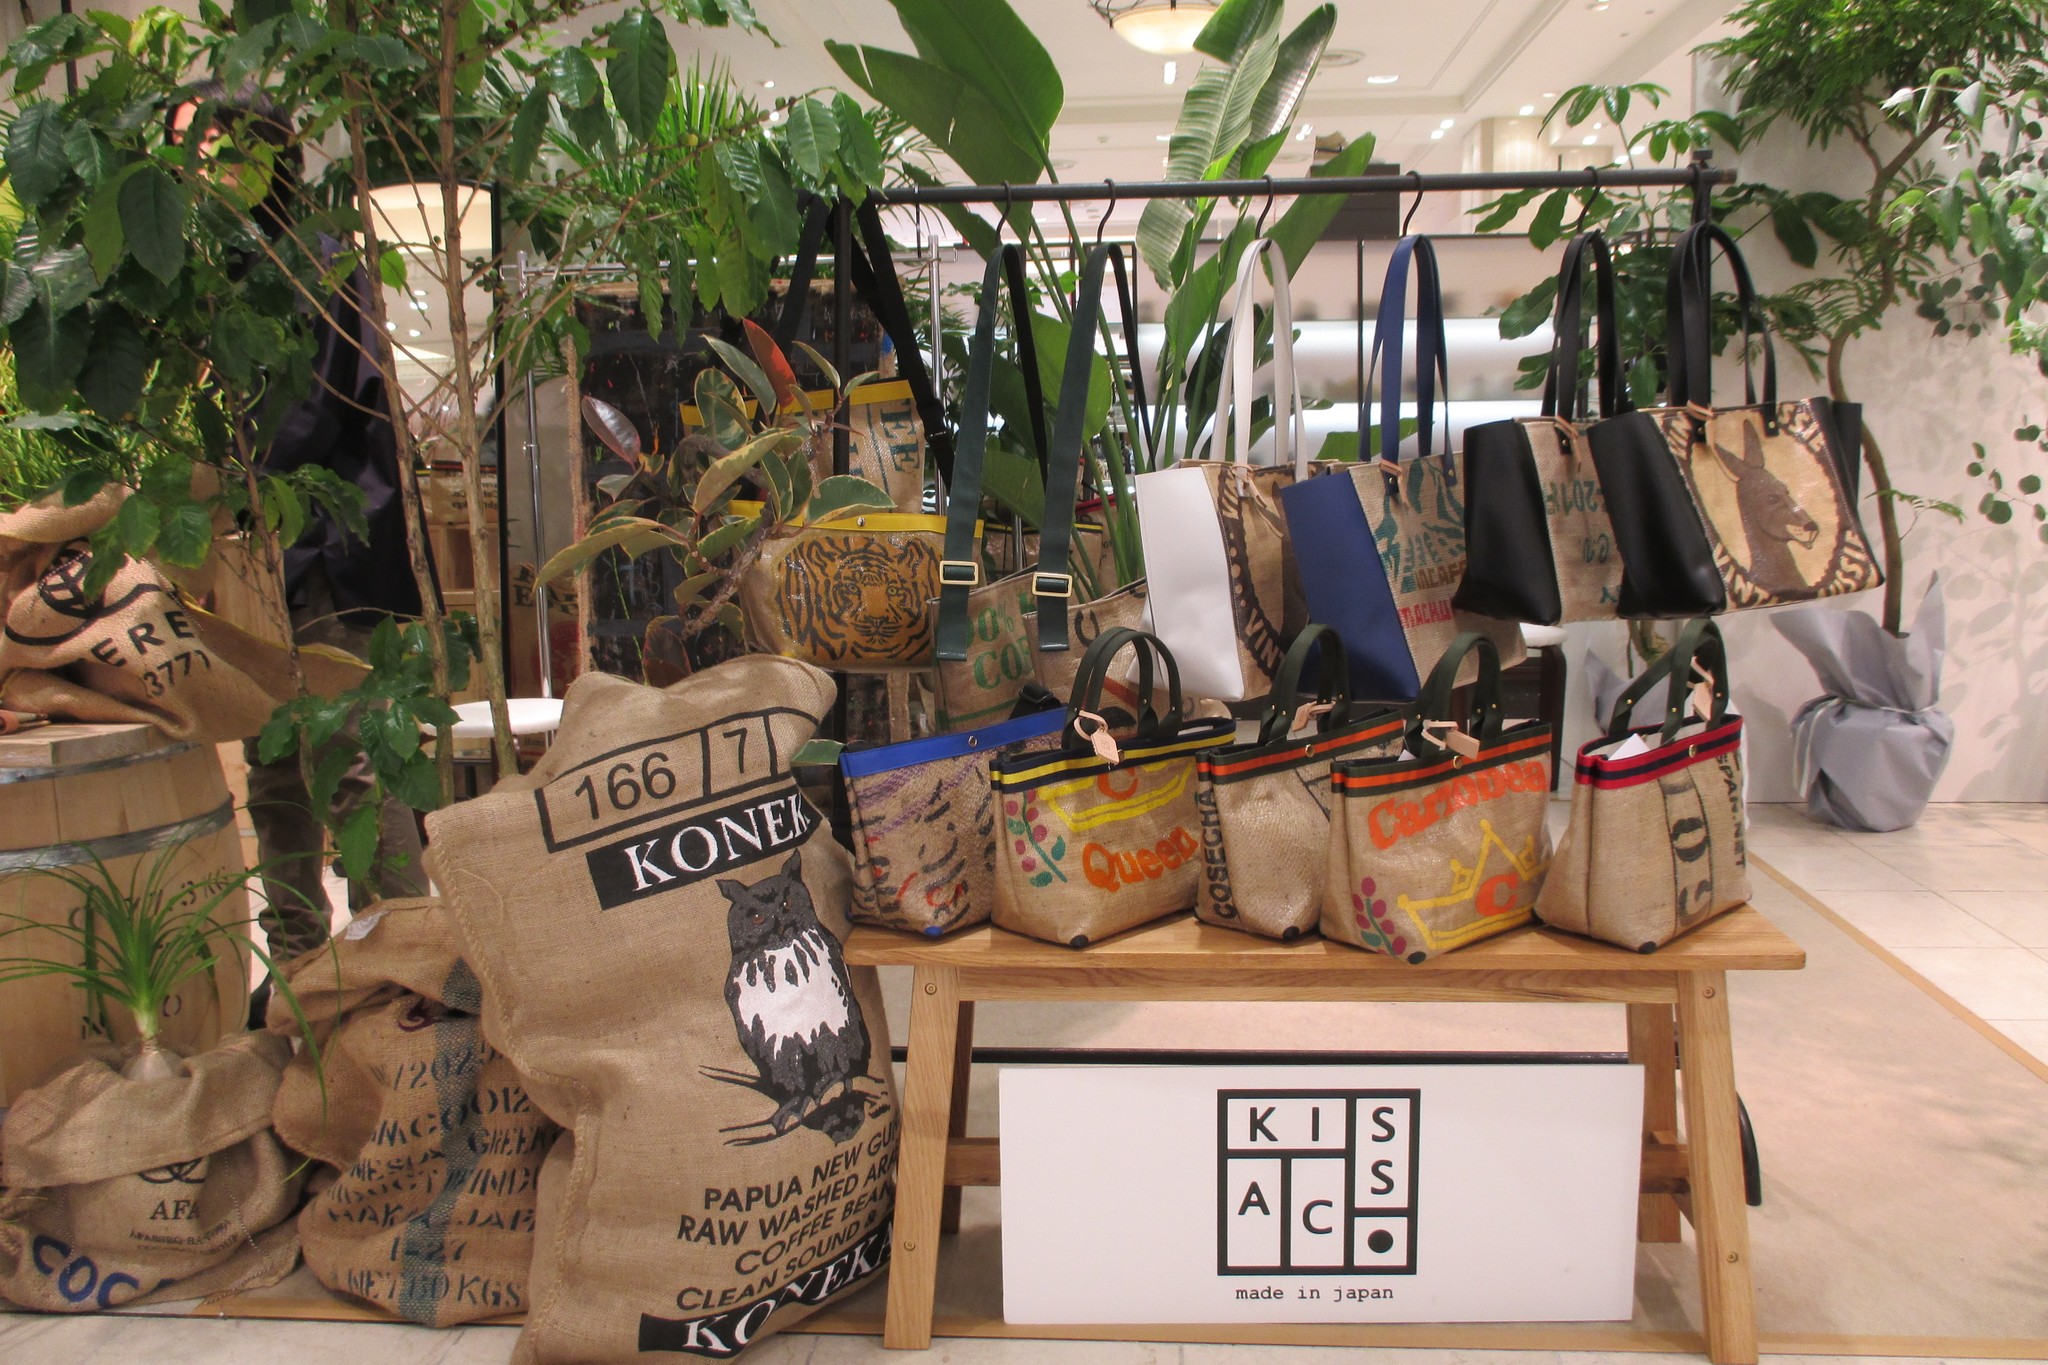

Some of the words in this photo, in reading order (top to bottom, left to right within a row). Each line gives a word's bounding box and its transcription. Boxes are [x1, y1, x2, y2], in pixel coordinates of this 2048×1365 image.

[575, 752, 676, 820] 166
[722, 727, 748, 774] 7
[1199, 790, 1238, 918] COSECHA
[1475, 872, 1518, 917] C
[677, 1214, 749, 1246] RAW
[758, 1173, 859, 1240] WASHED
[704, 1175, 803, 1213] PAPUA
[811, 1141, 864, 1189] NEW
[676, 1269, 778, 1311] CLEAN
[783, 1221, 860, 1280] SOUND
[734, 1207, 837, 1275] COFFEE
[456, 1272, 521, 1307] KGS
[1235, 1286, 1285, 1300] made
[1297, 1286, 1321, 1300] in
[1333, 1286, 1394, 1303] japan
